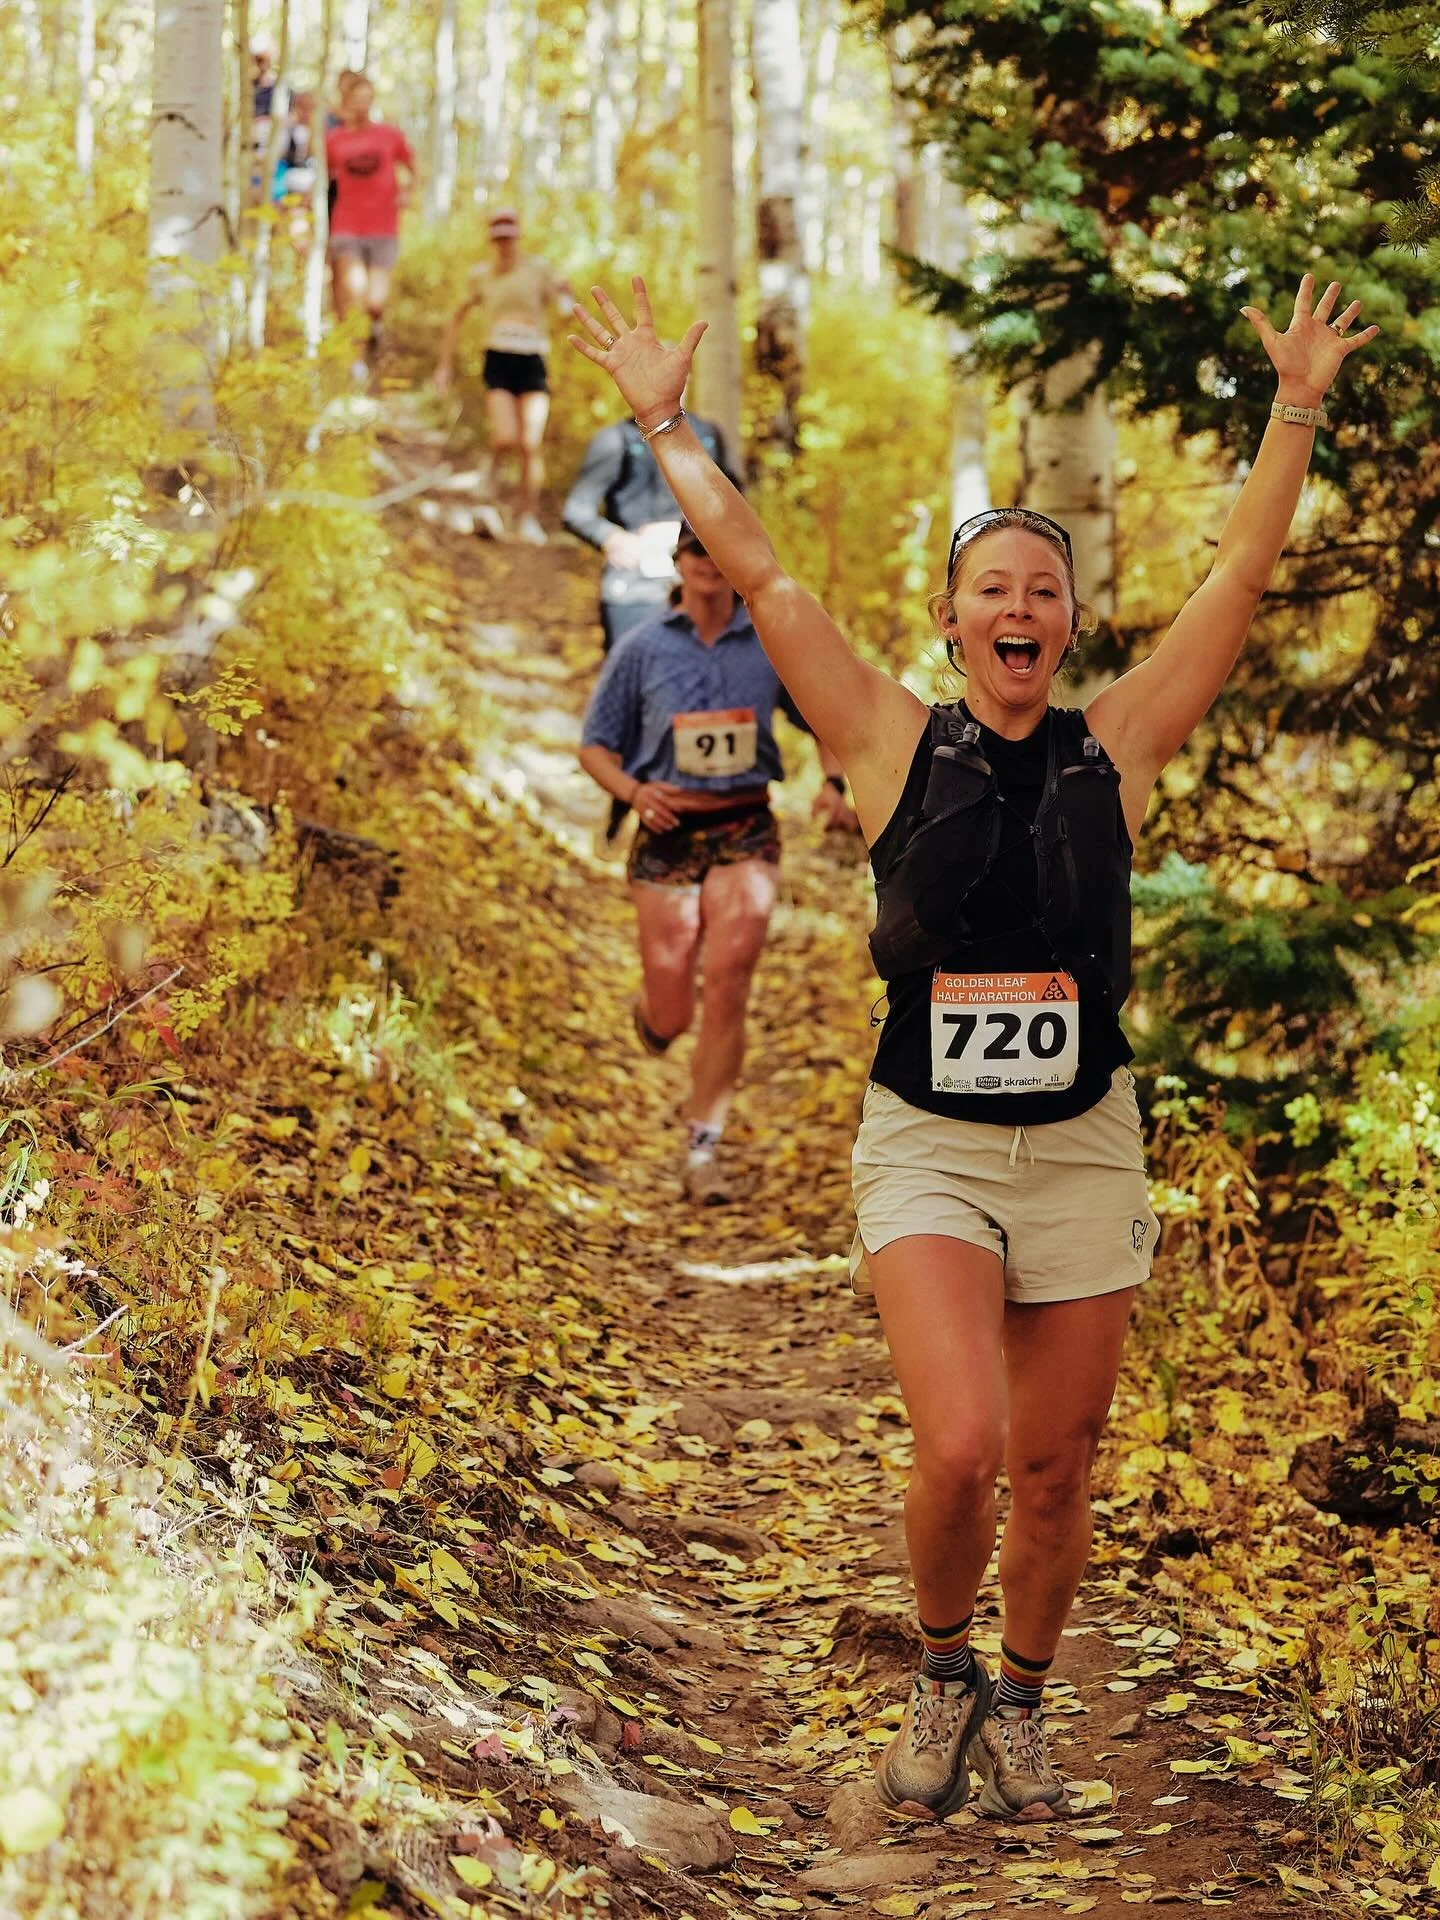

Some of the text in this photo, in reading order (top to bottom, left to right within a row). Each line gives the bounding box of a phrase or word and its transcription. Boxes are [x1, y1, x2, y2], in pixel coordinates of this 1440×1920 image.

[696, 732, 735, 757] 91
[945, 977, 1027, 988] GOLDEN LEAF
[936, 991, 1036, 1002] HALF MARATHON
[942, 1012, 1067, 1060] 720
